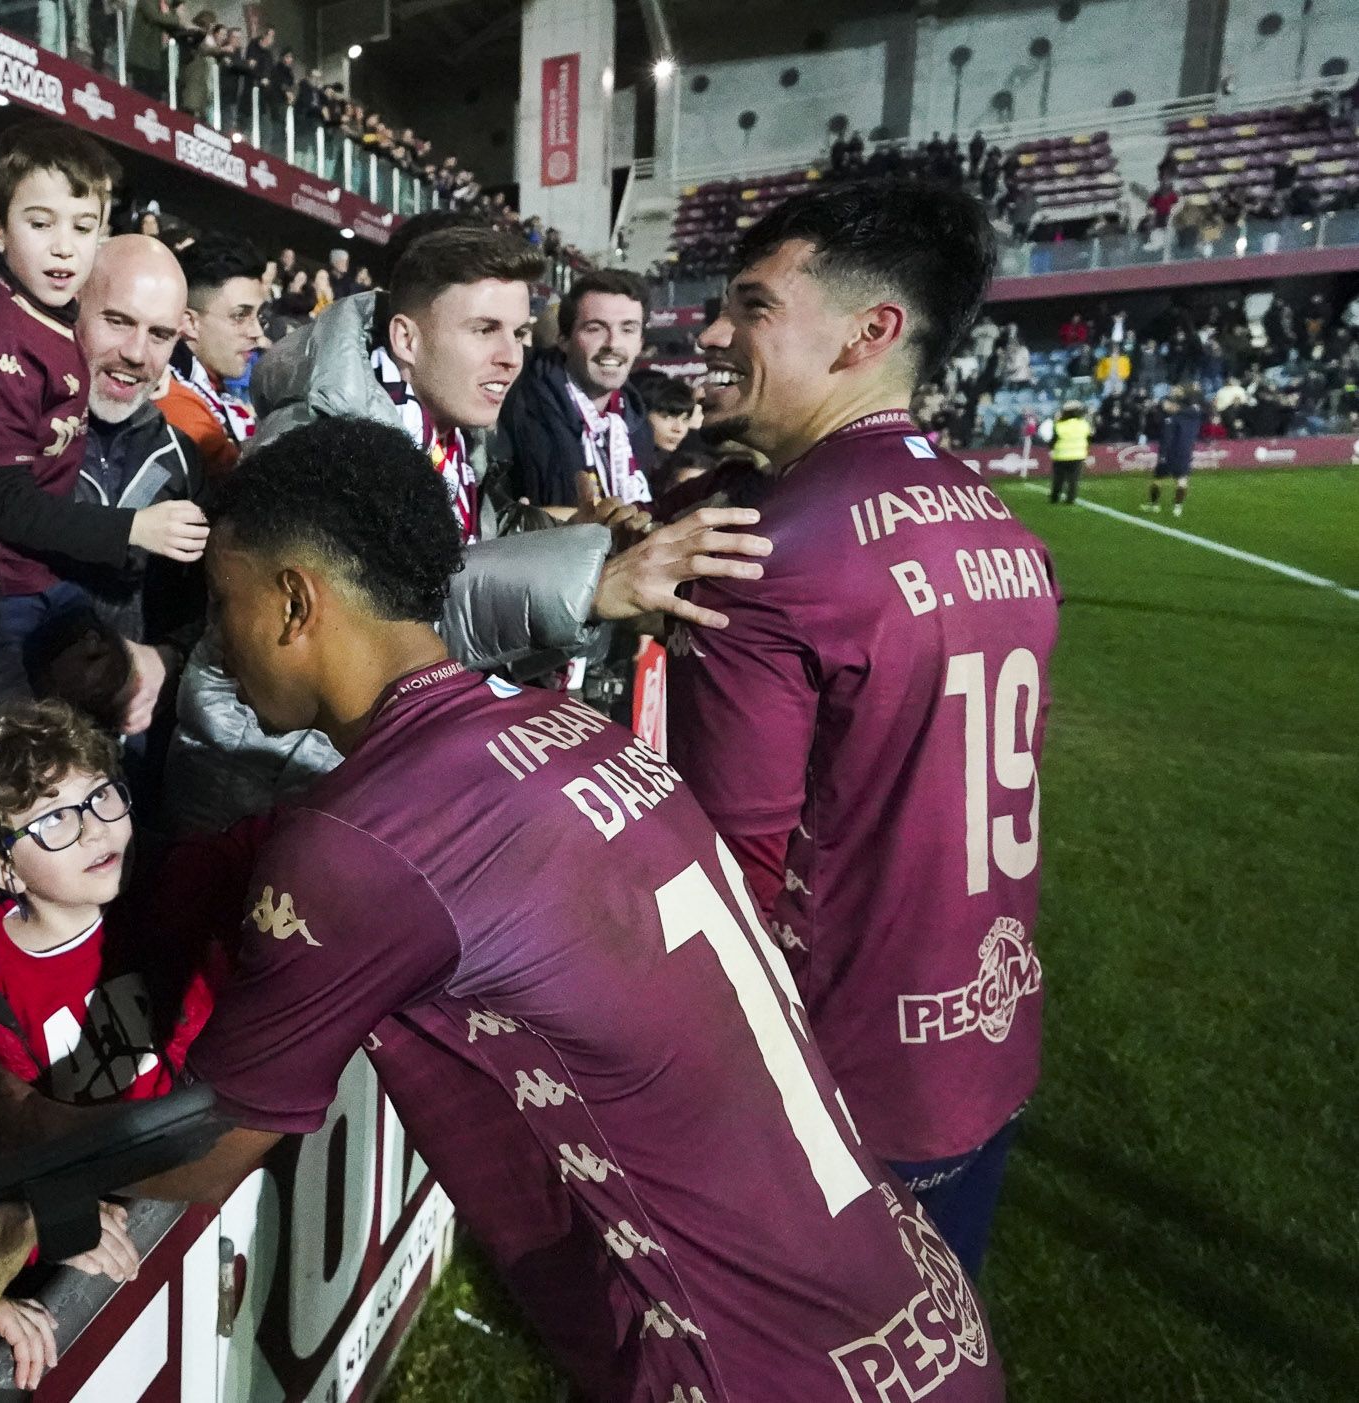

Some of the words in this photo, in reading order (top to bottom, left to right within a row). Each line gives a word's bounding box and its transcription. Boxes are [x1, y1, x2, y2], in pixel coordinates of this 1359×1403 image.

[889, 559, 955, 617] B.
[955, 547, 1053, 602] GARAY
[944, 648, 1040, 896] 19
